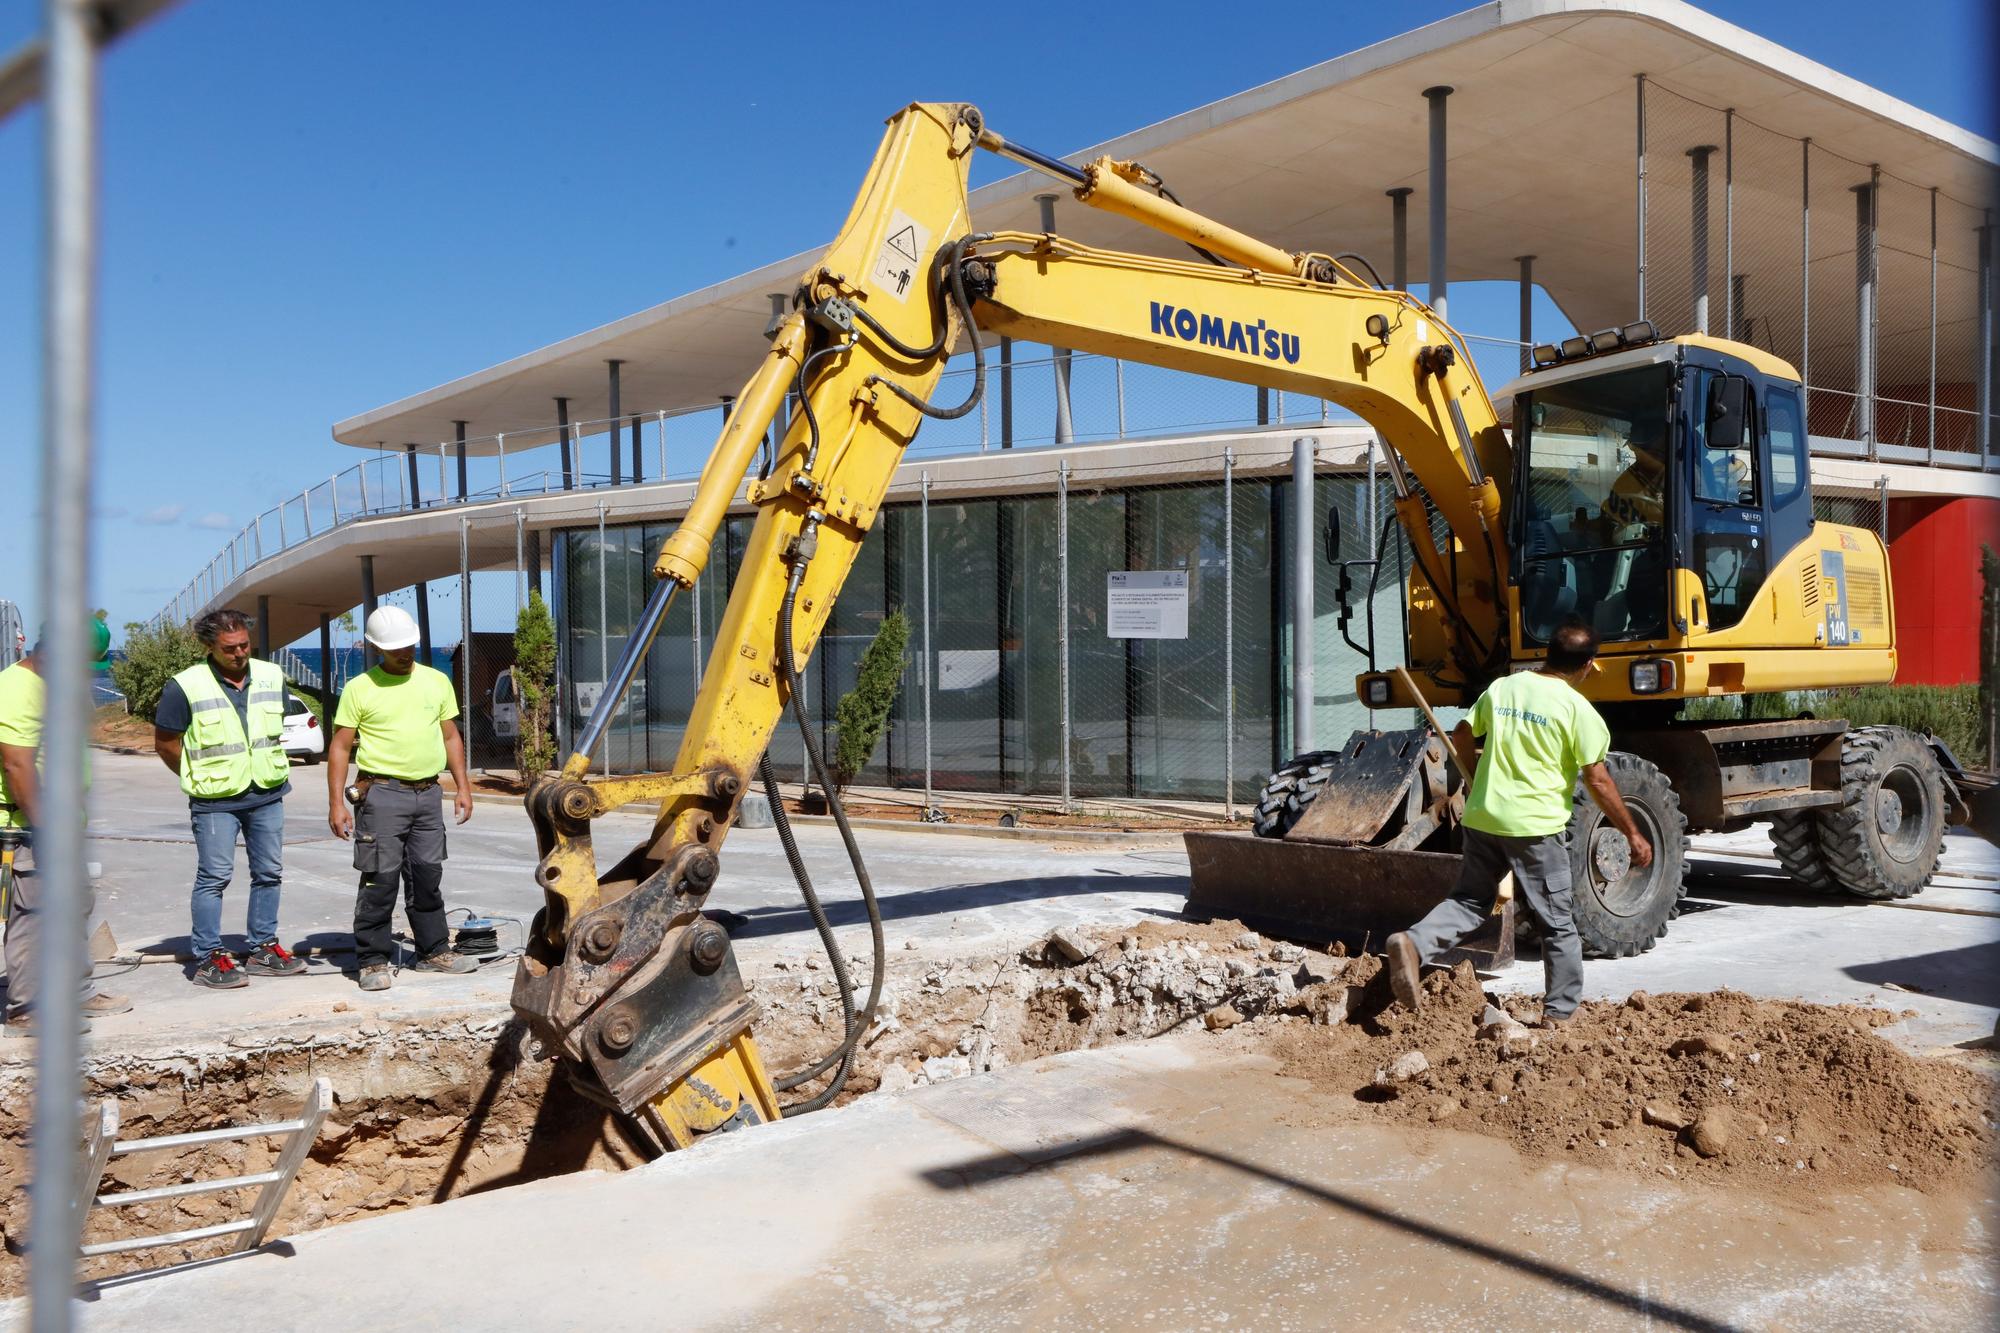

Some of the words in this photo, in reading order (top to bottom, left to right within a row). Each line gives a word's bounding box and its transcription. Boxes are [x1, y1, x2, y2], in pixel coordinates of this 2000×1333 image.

[1150, 301, 1300, 364] KOMATSU
[1829, 604, 1841, 619] PW
[1830, 620, 1846, 641] 140
